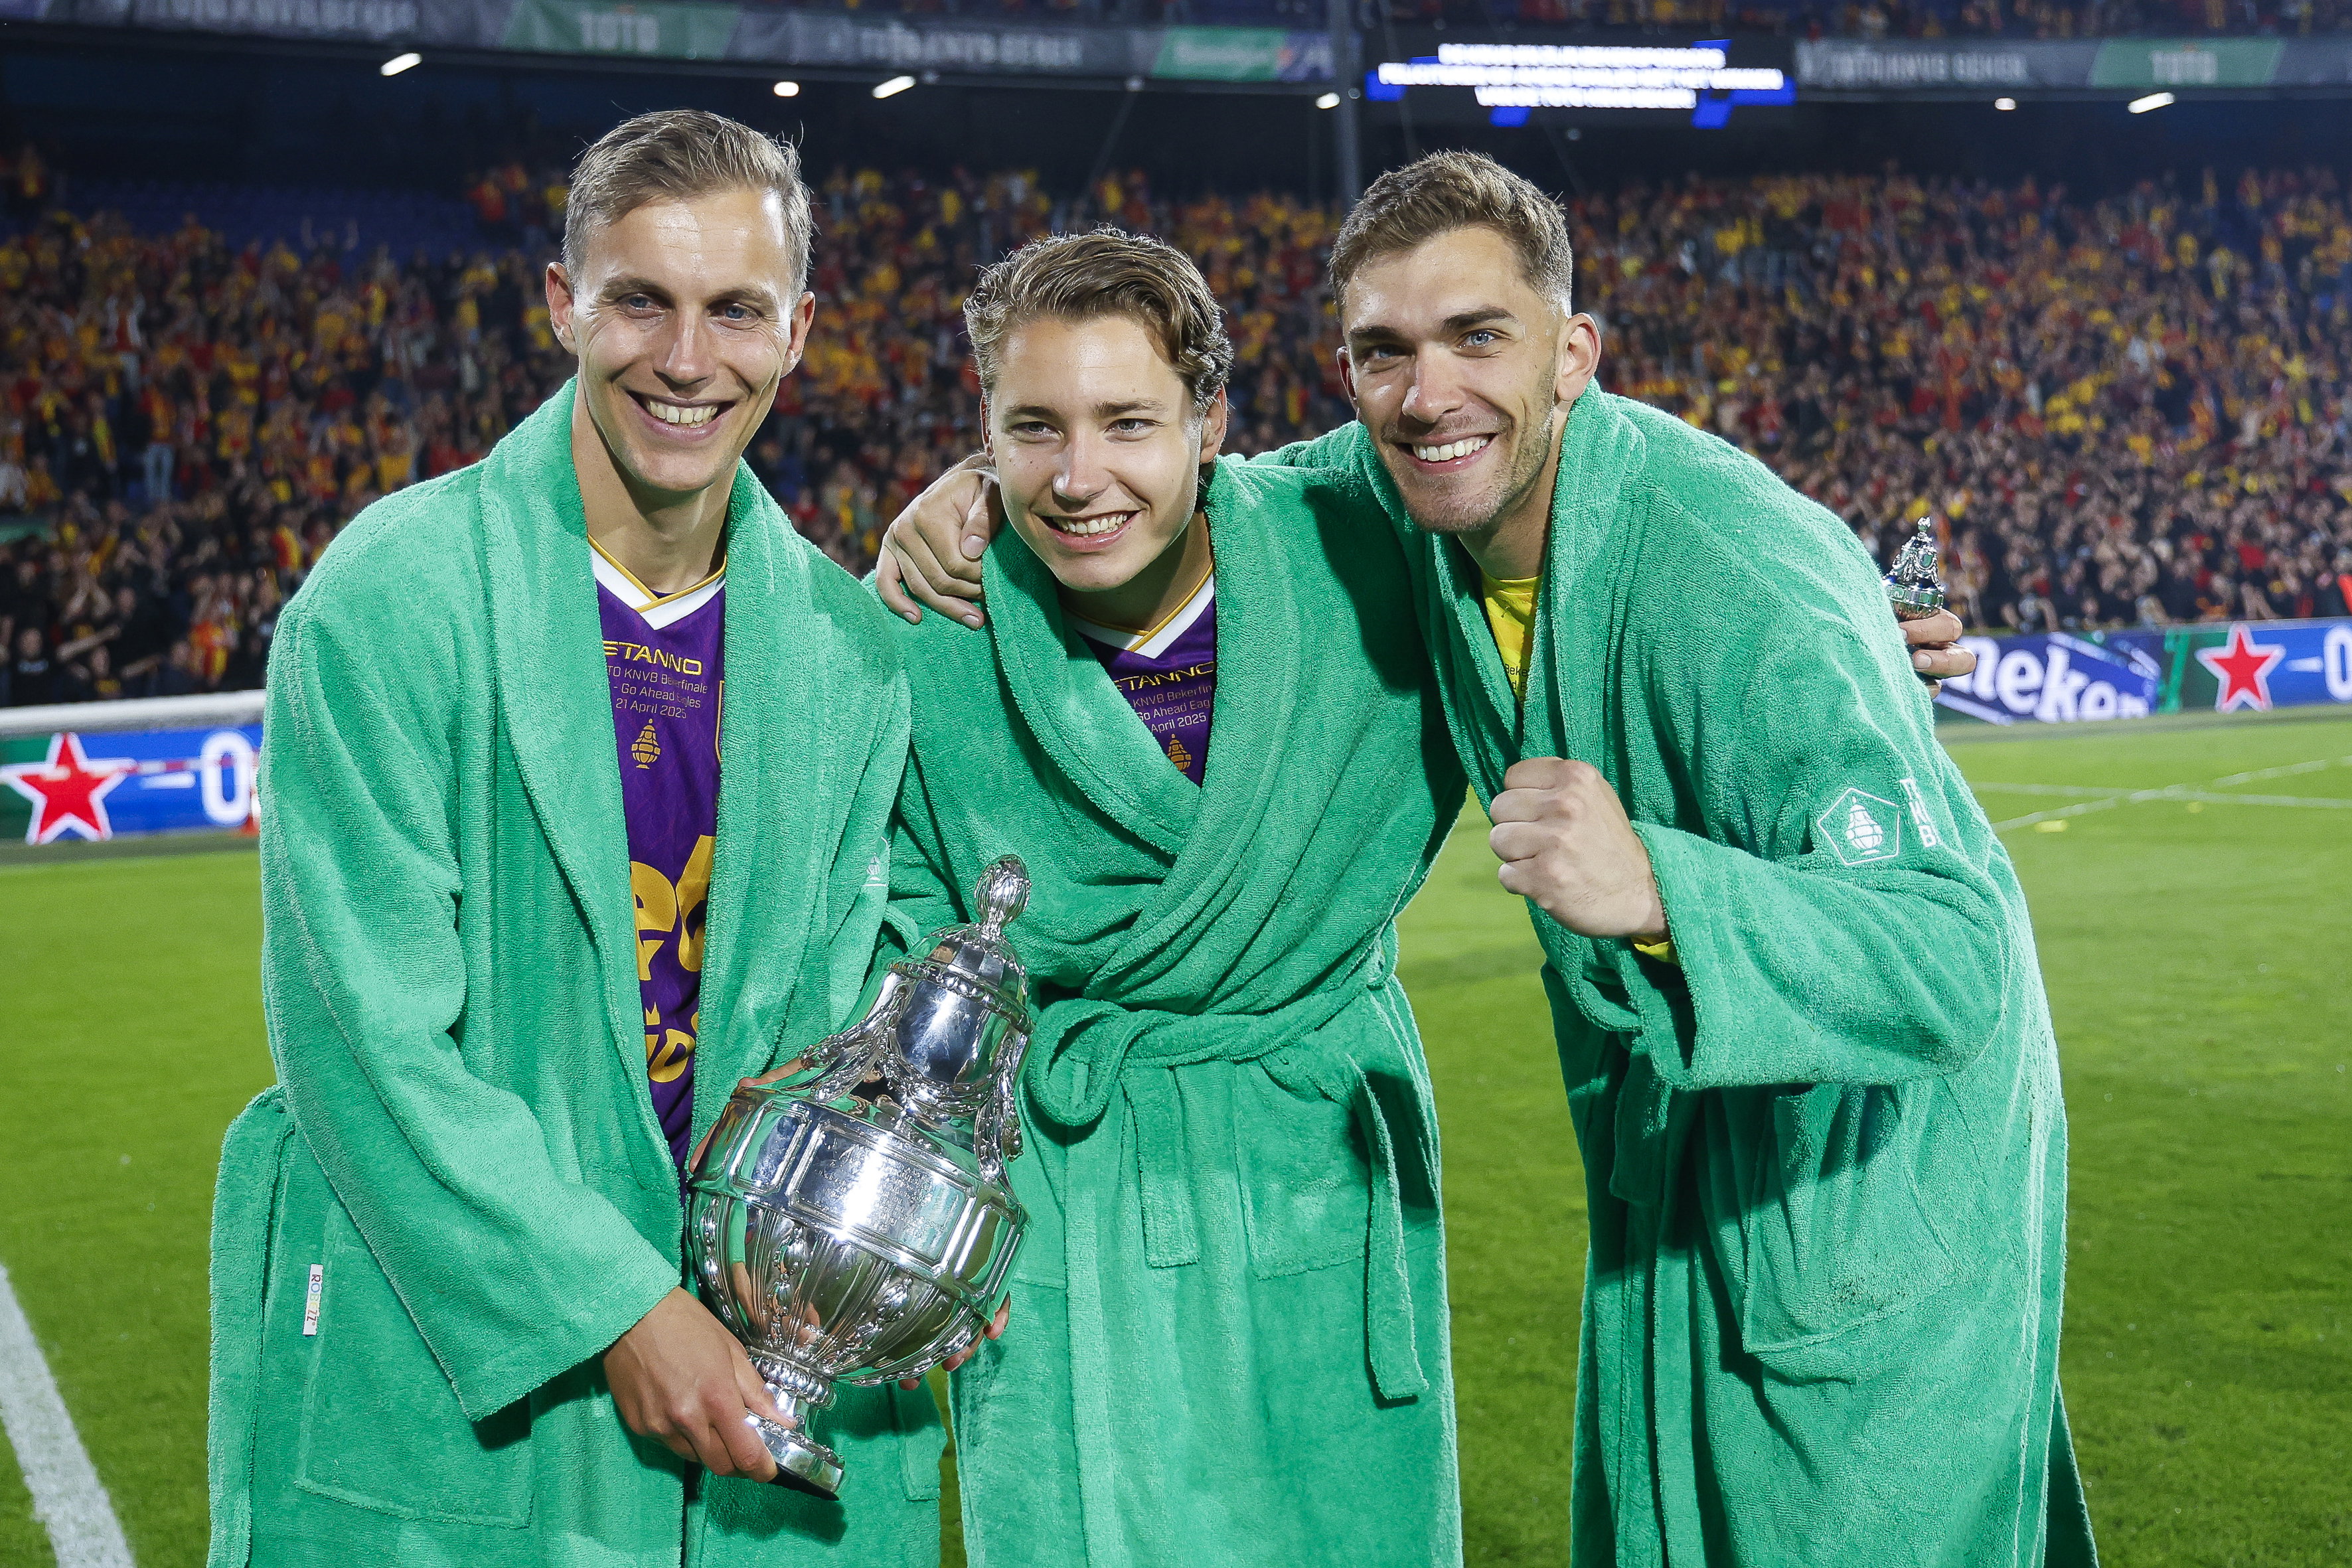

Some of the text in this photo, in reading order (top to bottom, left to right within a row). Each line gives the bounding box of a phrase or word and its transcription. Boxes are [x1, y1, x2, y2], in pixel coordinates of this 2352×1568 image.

[624, 668, 658, 682] KNVB
[621, 683, 637, 694] Go
[639, 687, 675, 701] Ahead
[615, 698, 686, 719] 21 April 2025
[1133, 693, 1164, 708] KNVB
[1153, 703, 1187, 718] Ahead
[1151, 712, 1206, 734] April 2025
